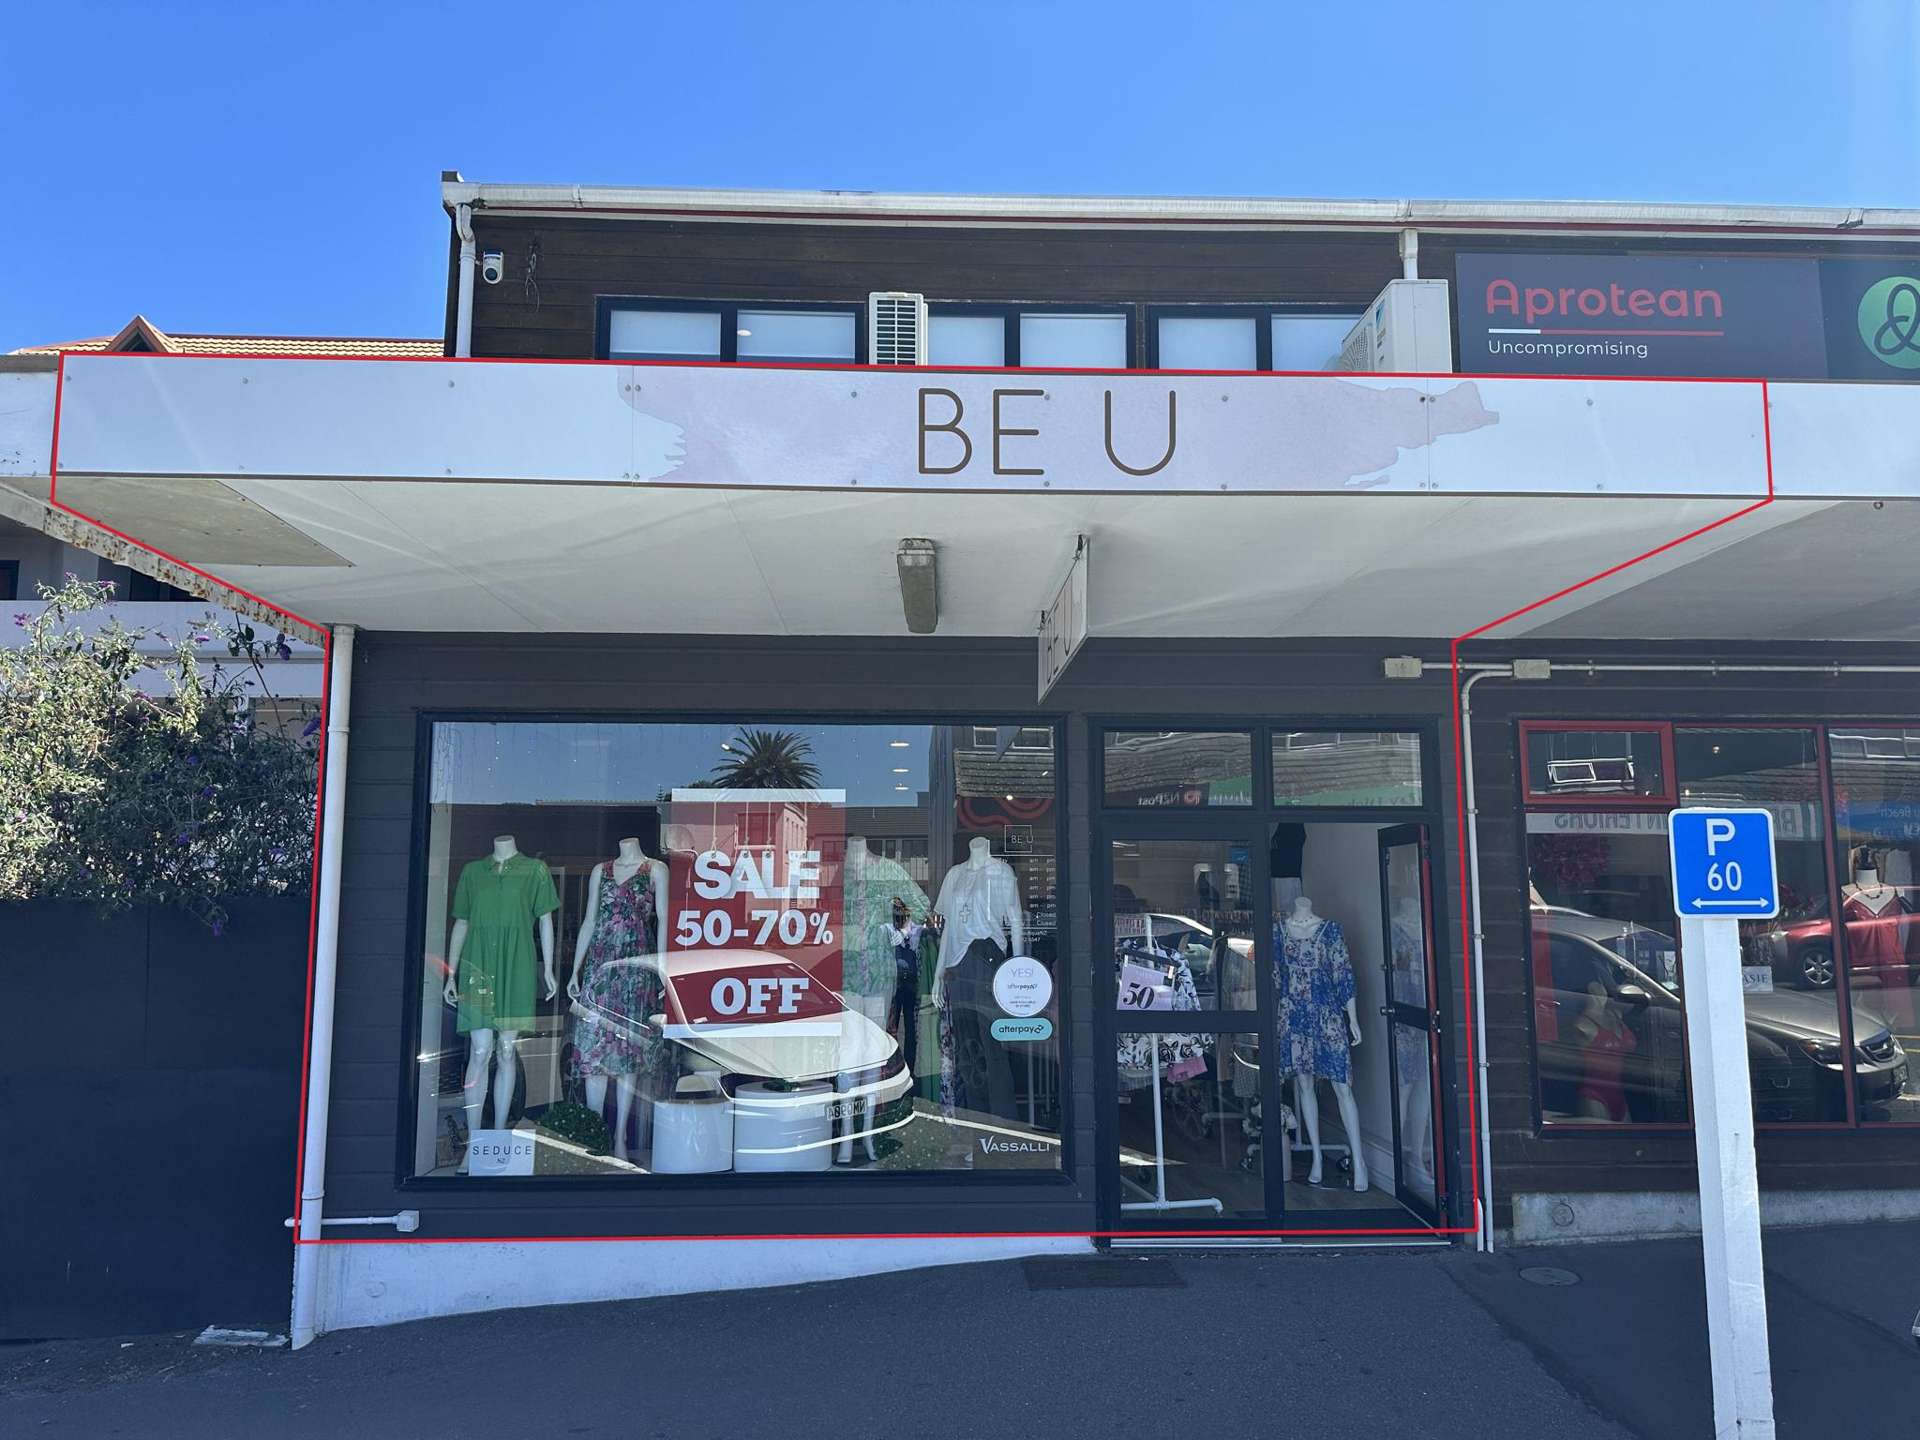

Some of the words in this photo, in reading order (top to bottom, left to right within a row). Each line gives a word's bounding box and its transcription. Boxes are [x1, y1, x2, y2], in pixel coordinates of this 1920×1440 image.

[1485, 278, 1723, 324] Aprotean
[1487, 339, 1649, 360] Uncompromising
[917, 387, 1045, 476] BE
[1104, 389, 1177, 477] U
[1011, 834, 1023, 844] BE
[1706, 817, 1736, 857] P
[693, 850, 820, 901] SALE
[1707, 860, 1743, 893] 60
[675, 910, 835, 947] 50-70%
[710, 977, 810, 1016] OFF
[1122, 982, 1155, 1010] 50
[998, 1024, 1035, 1035] afterpay
[472, 1145, 532, 1156] SEDUCE
[976, 1135, 1050, 1155] VASSALLI
